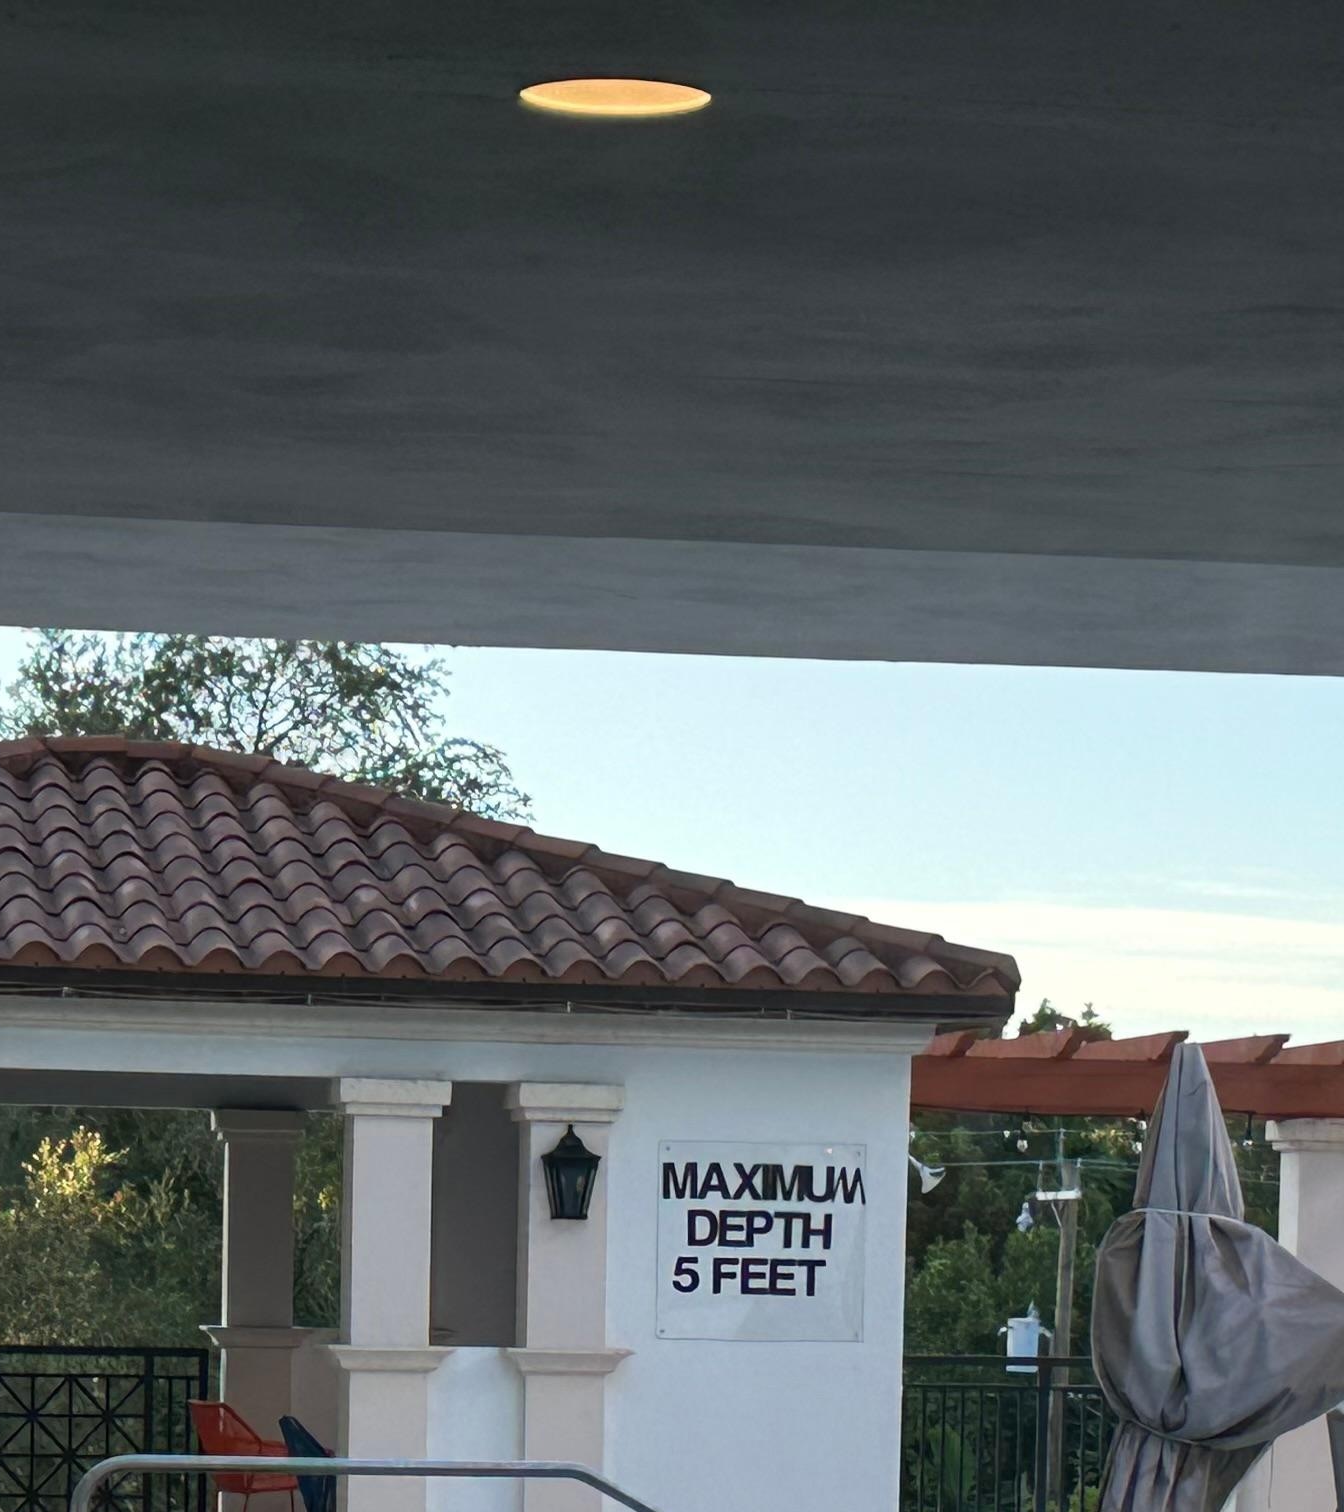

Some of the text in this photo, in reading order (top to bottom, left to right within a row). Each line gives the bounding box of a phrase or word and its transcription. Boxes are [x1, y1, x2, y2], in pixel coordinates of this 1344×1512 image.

[662, 1162, 866, 1205] MAXIMUM
[687, 1209, 833, 1250] DEPTH
[672, 1256, 827, 1297] 5 FEET
